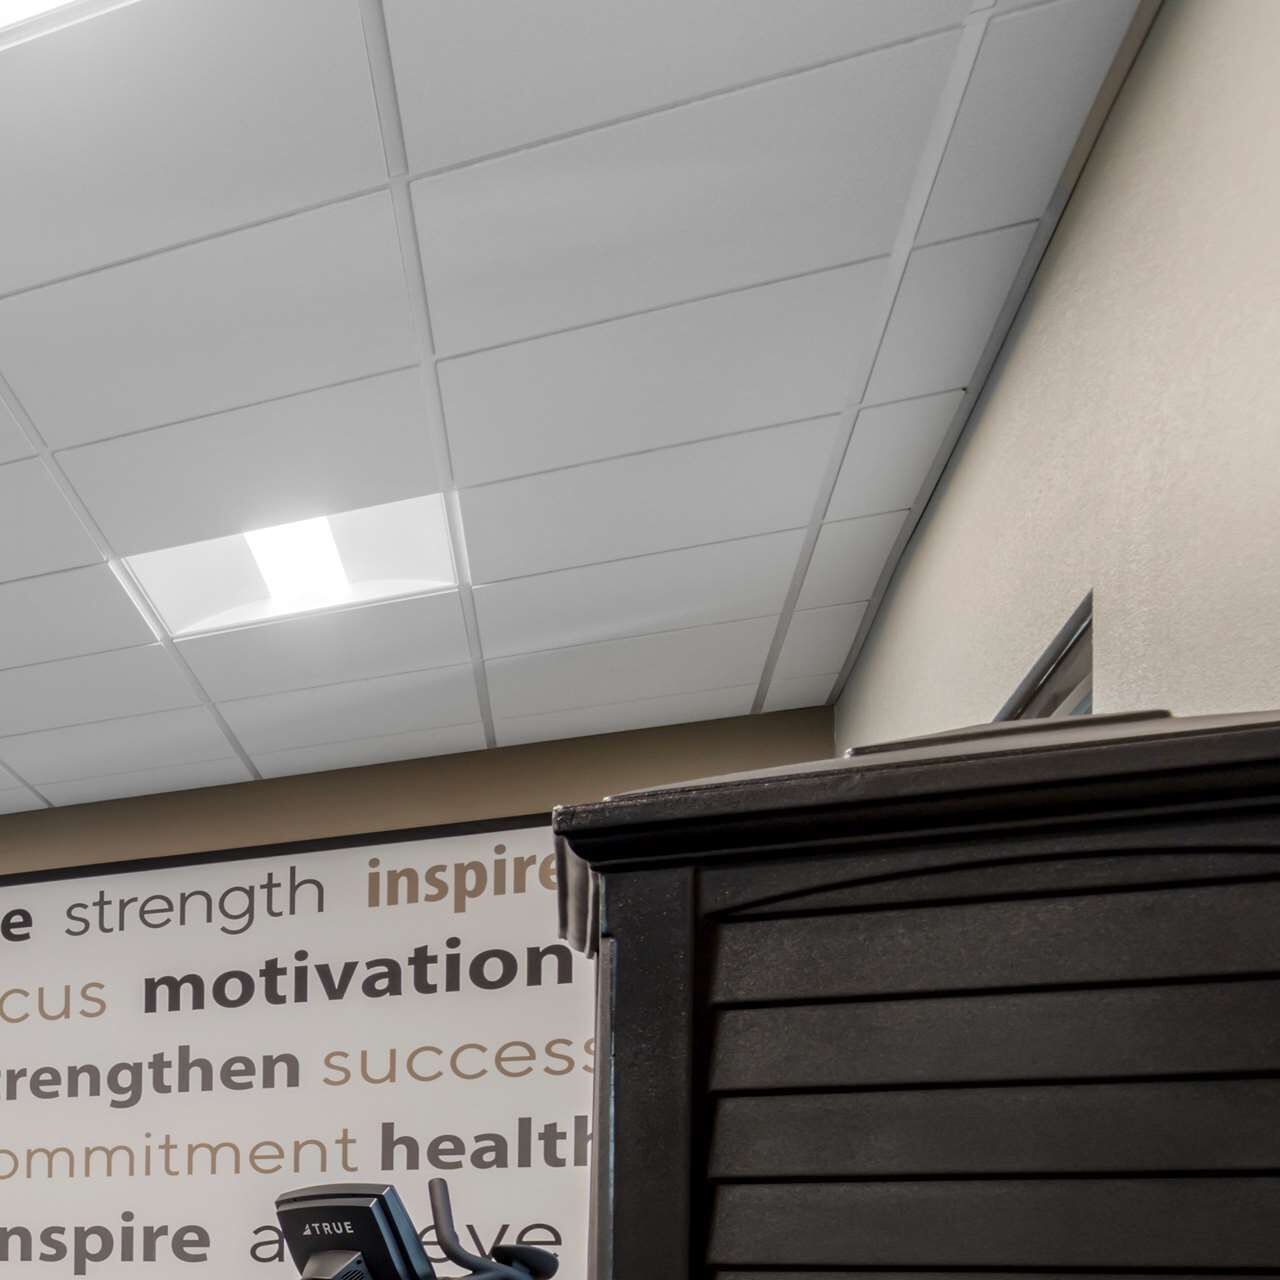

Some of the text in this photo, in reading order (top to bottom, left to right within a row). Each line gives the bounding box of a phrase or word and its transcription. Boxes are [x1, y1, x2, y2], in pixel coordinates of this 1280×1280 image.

[64, 866, 325, 937] strength
[367, 843, 558, 914] inspire
[143, 936, 574, 1014] motivation
[312, 1222, 354, 1235] TRUE
